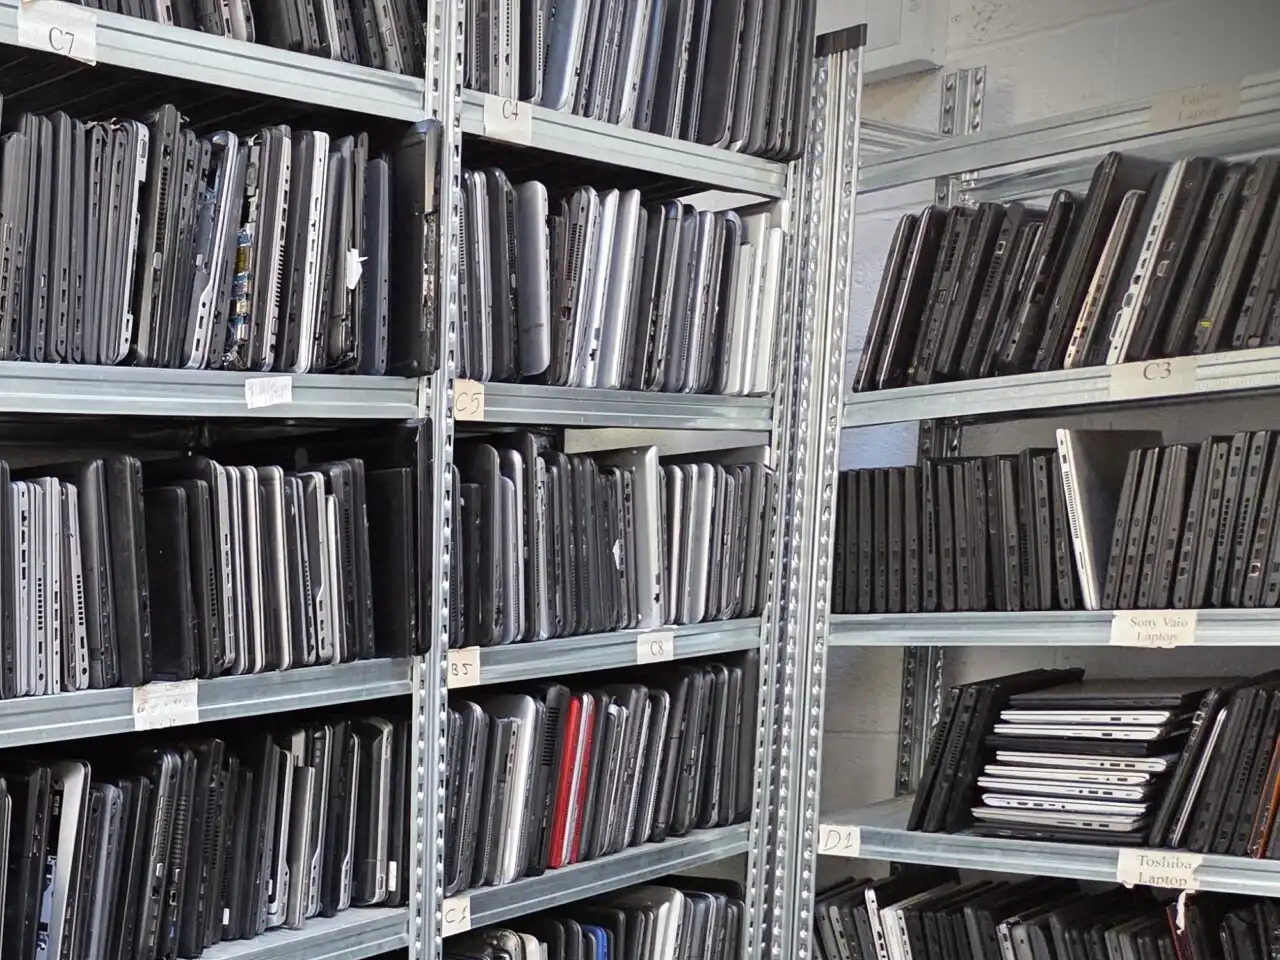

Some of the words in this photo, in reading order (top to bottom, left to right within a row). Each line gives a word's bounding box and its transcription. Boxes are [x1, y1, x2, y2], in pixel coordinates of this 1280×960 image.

[49, 26, 75, 55] C7
[502, 99, 519, 120] C4
[1143, 361, 1172, 380] C3
[455, 392, 482, 415] C5
[1130, 616, 1157, 629] Sony
[1162, 616, 1188, 628] Vaio
[1137, 631, 1178, 645] Laptop
[650, 640, 663, 656] C8
[451, 662, 473, 676] B5
[822, 829, 853, 851] D1
[1136, 854, 1192, 870] Toshiba
[1138, 871, 1188, 887] Laptop
[445, 905, 467, 923] C1
